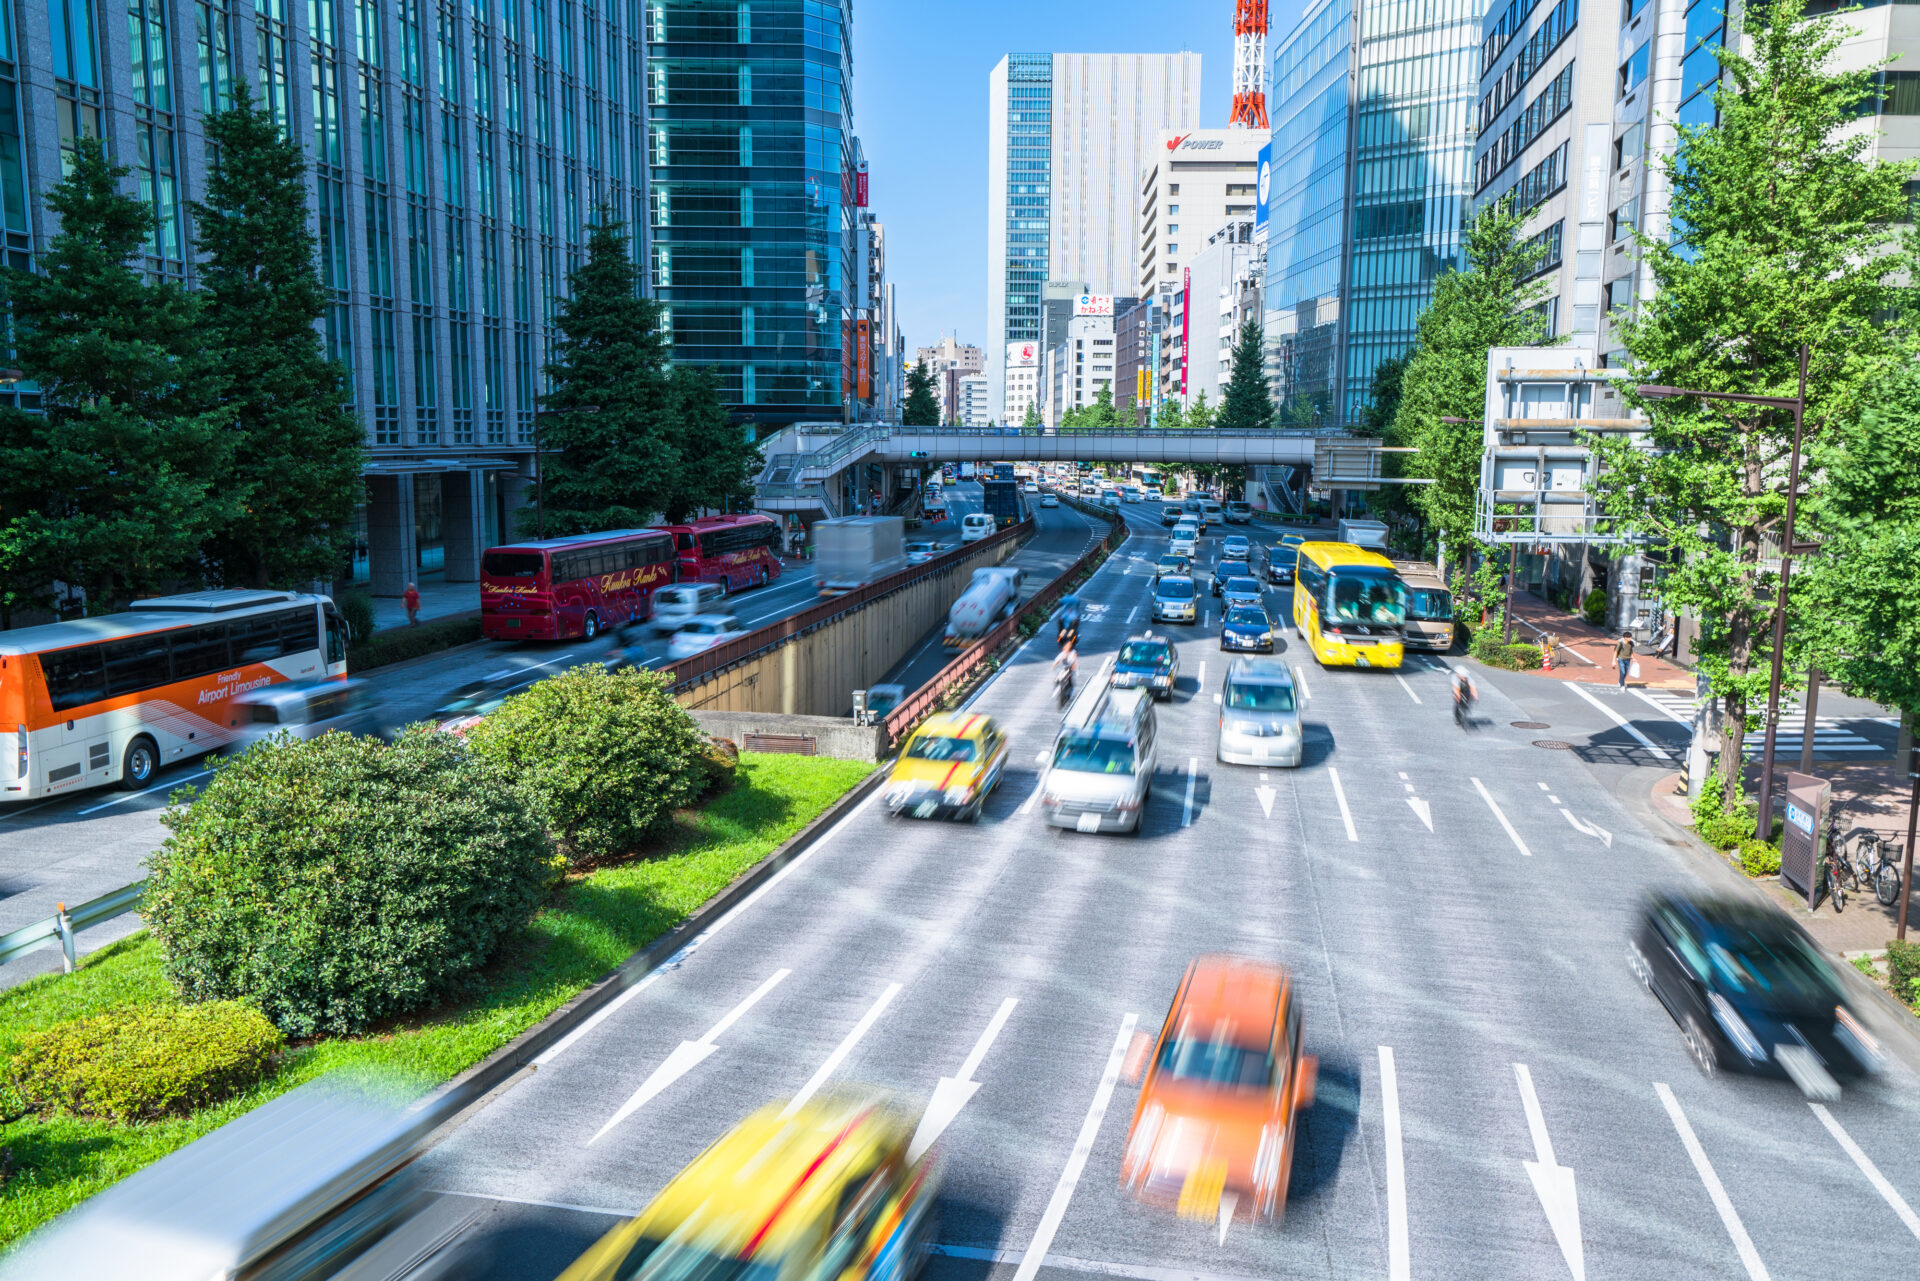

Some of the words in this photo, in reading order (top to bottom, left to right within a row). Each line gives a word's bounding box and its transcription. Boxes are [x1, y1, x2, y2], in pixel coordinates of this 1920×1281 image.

[1181, 140, 1224, 150] POWER
[1081, 305, 1110, 314] かねふく
[217, 671, 242, 684] Friendly
[197, 684, 228, 704] Airport
[230, 675, 271, 696] Limousine
